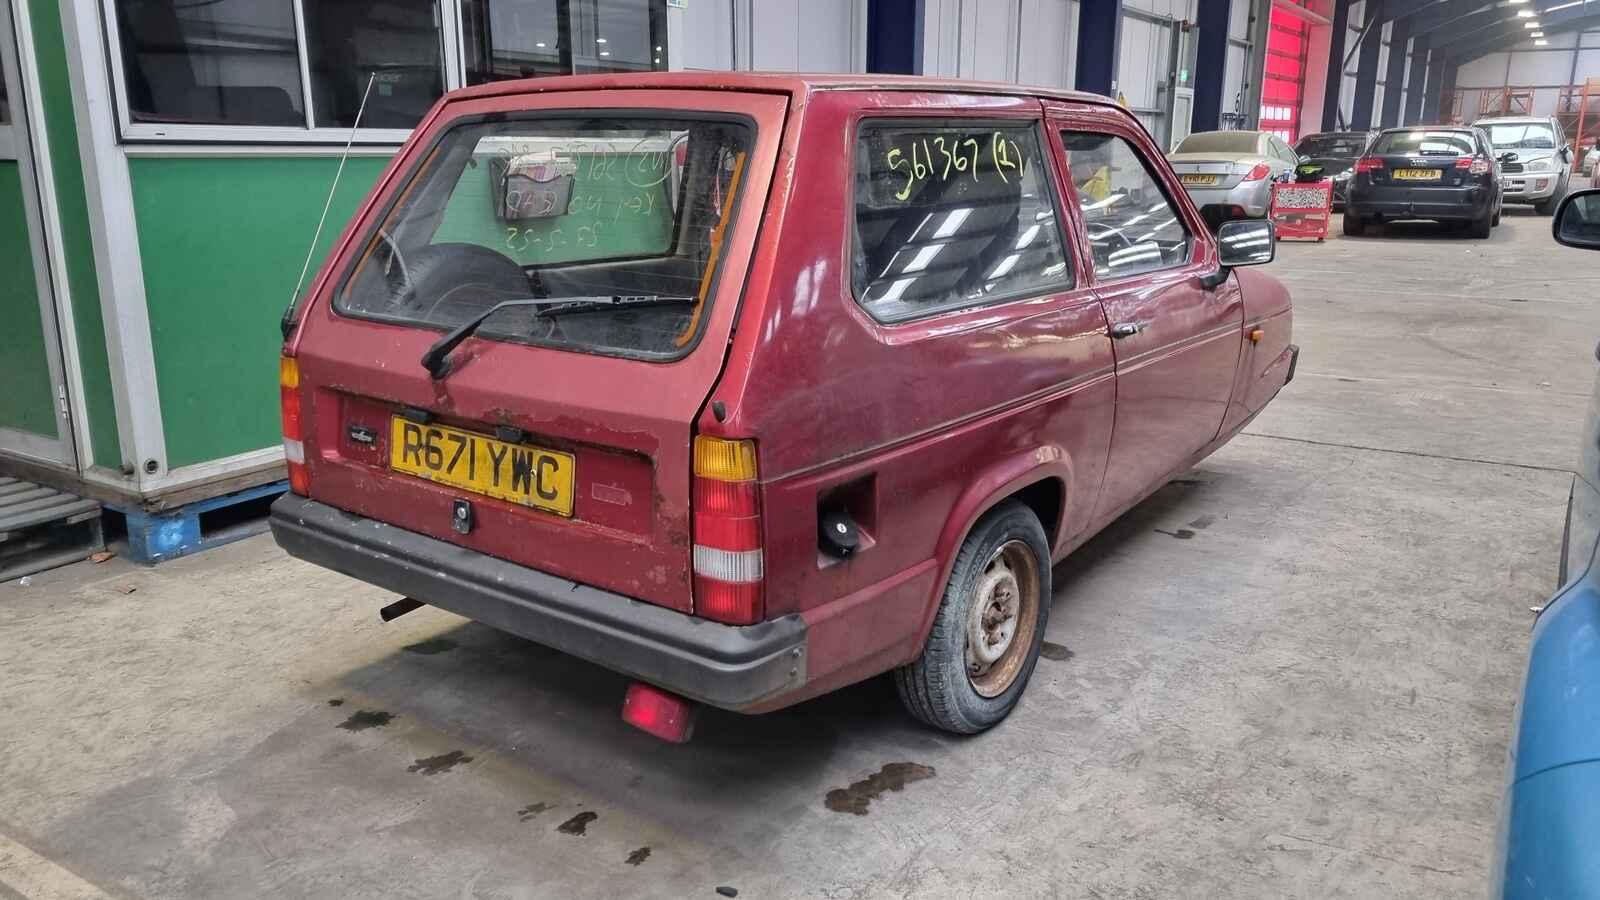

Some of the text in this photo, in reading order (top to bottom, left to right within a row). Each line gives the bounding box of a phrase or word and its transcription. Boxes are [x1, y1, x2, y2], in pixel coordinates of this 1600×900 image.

[887, 136, 979, 200] 561367
[402, 422, 476, 481] R671
[486, 441, 560, 501] YWC
